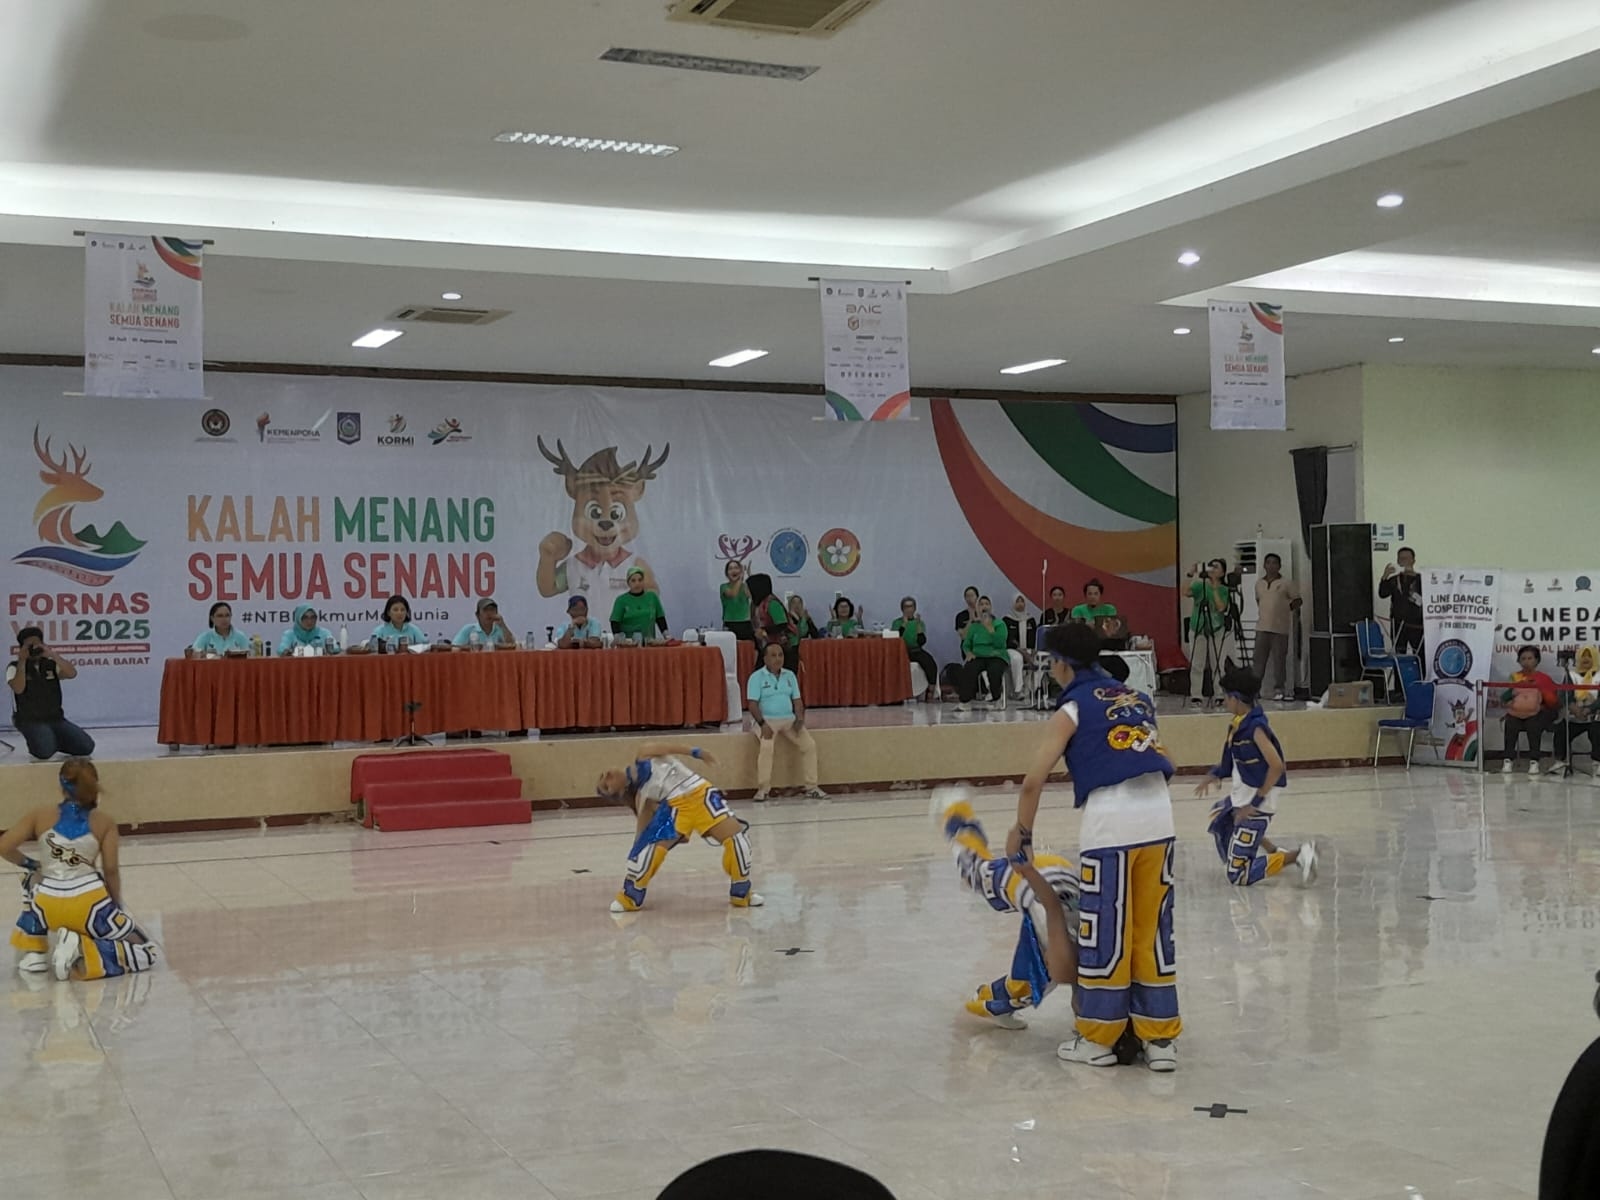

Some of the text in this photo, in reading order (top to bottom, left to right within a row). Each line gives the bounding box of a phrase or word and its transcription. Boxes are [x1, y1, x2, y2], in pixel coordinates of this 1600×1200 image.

[110, 314, 180, 328] SEMUA SENANG
[377, 436, 414, 446] KORMI
[187, 495, 495, 542] KALAH MENANG
[188, 552, 495, 600] SEMUA SENANG
[9, 592, 150, 616] FORNAS
[1453, 594, 1490, 605] DANCE
[75, 619, 150, 640] 2025
[113, 656, 150, 665] BARAT
